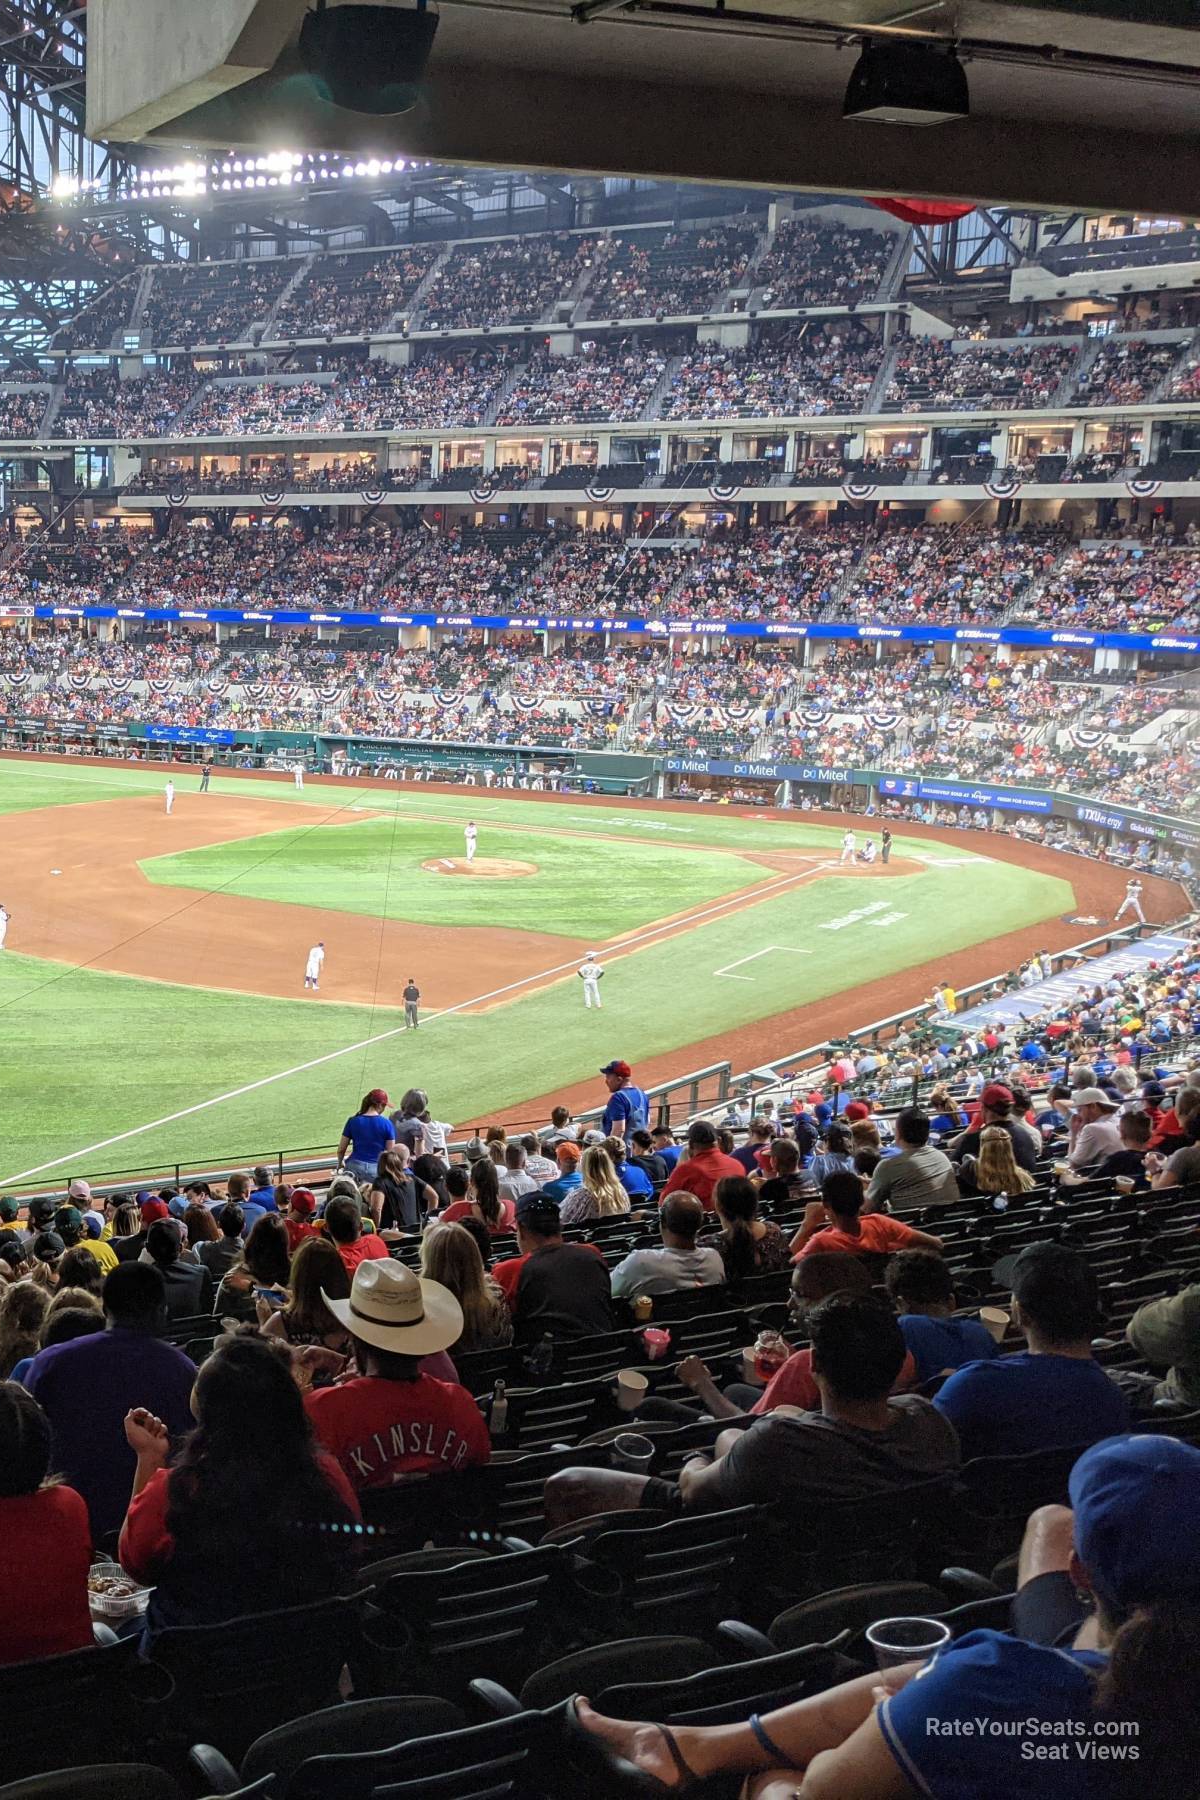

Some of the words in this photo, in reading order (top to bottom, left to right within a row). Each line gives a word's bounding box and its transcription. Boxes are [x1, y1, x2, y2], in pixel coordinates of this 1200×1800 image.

[681, 760, 709, 772] Mitel
[749, 764, 778, 777] Mitel
[818, 769, 848, 782] Mitel
[971, 791, 992, 803] Kroger
[350, 1422, 468, 1478] KINSLER
